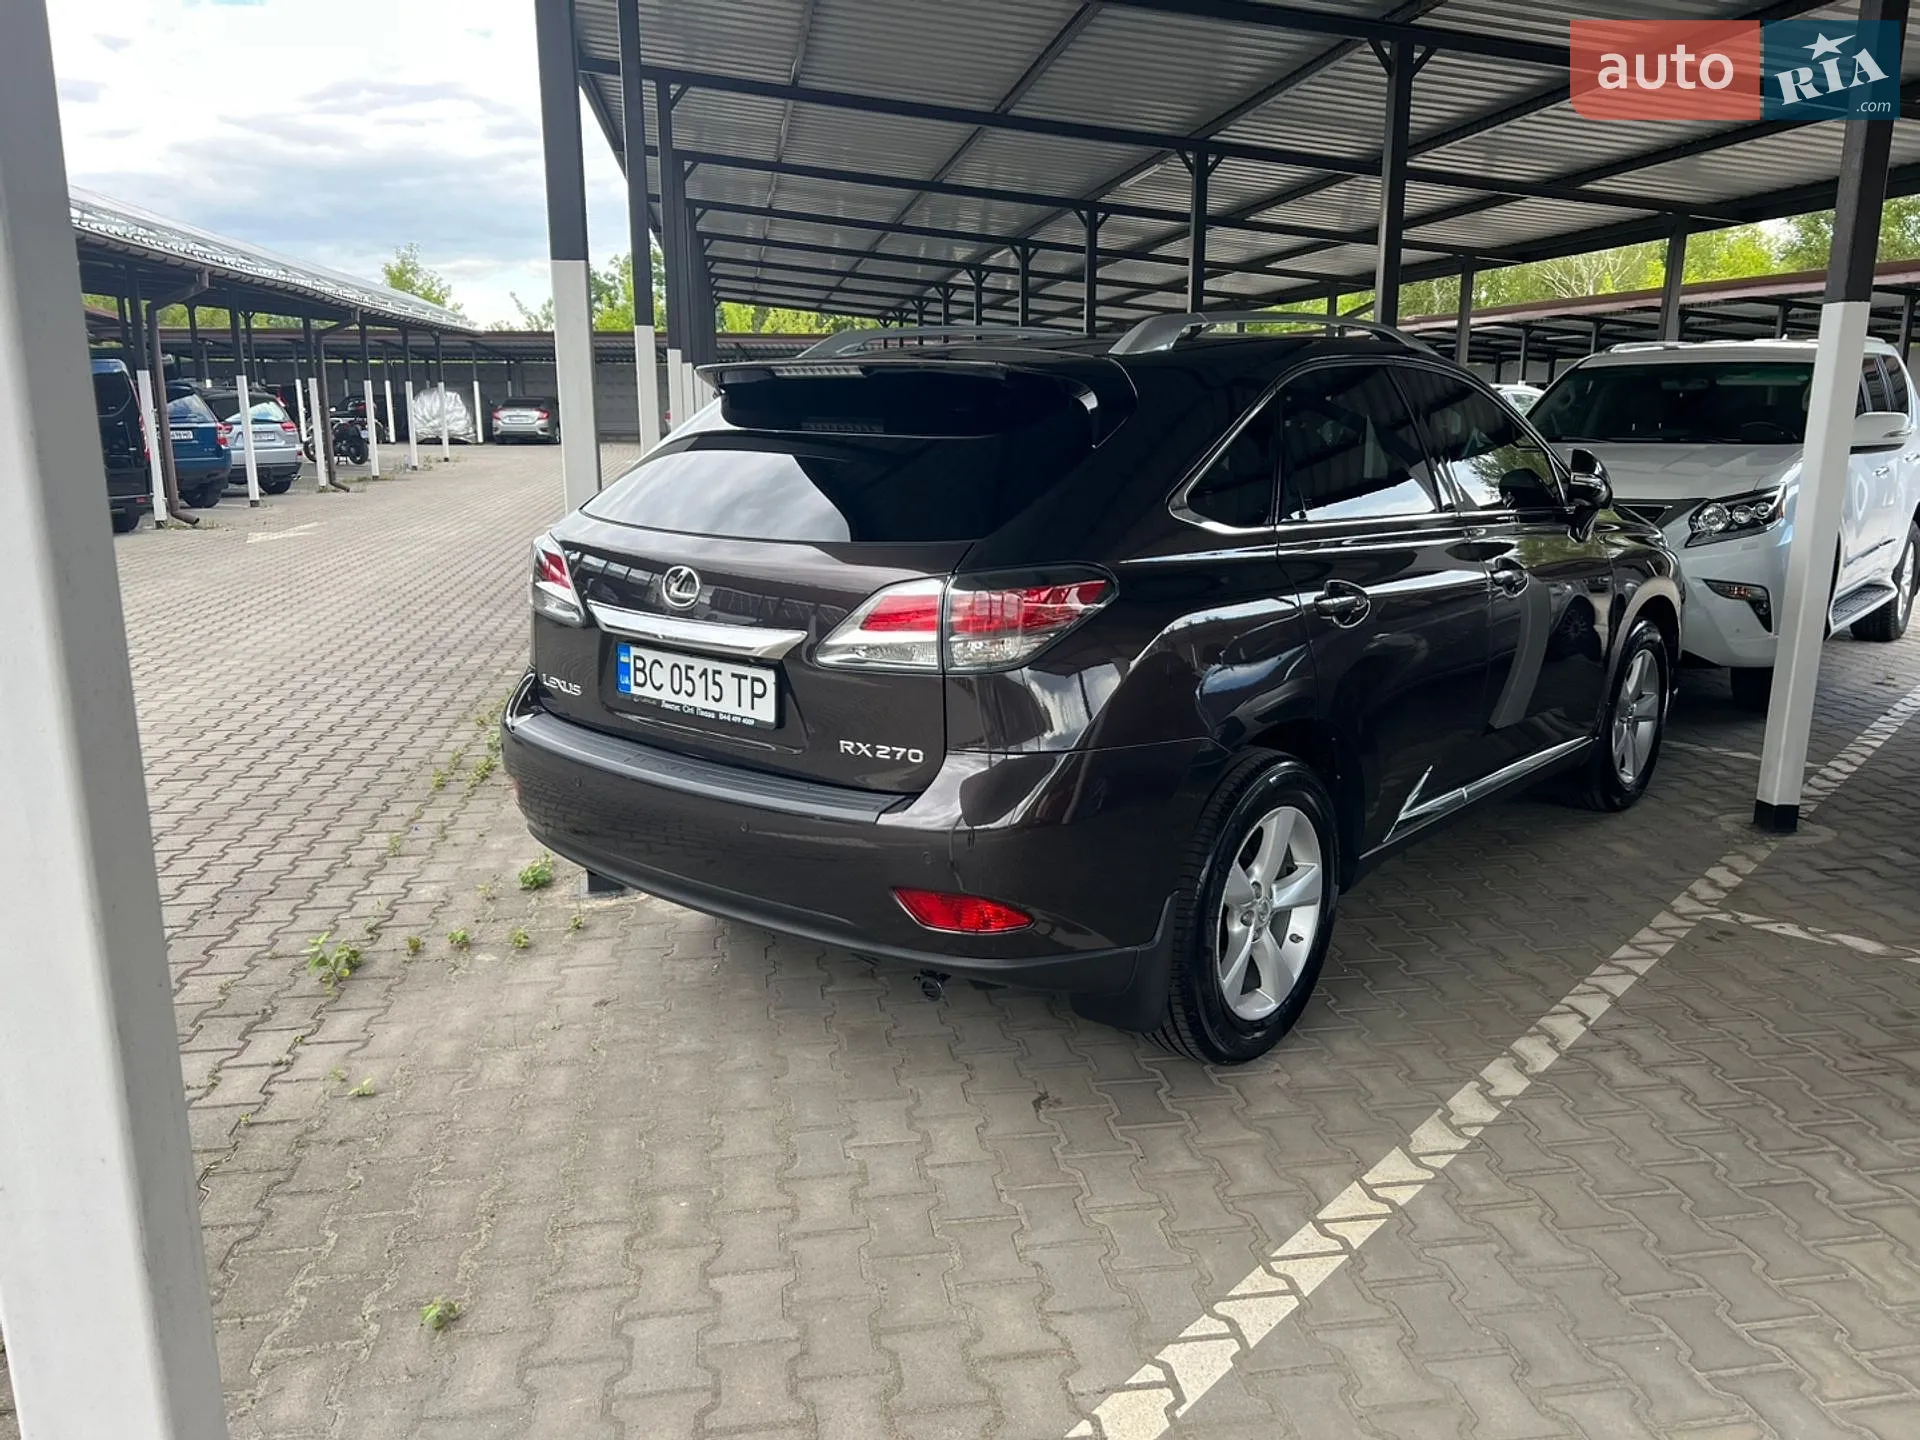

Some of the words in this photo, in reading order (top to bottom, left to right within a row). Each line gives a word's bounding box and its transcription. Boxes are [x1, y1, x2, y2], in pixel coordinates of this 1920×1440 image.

[542, 673, 582, 696] LEXUS
[633, 655, 664, 691] BC
[670, 663, 723, 703] 0515
[731, 672, 767, 710] TP
